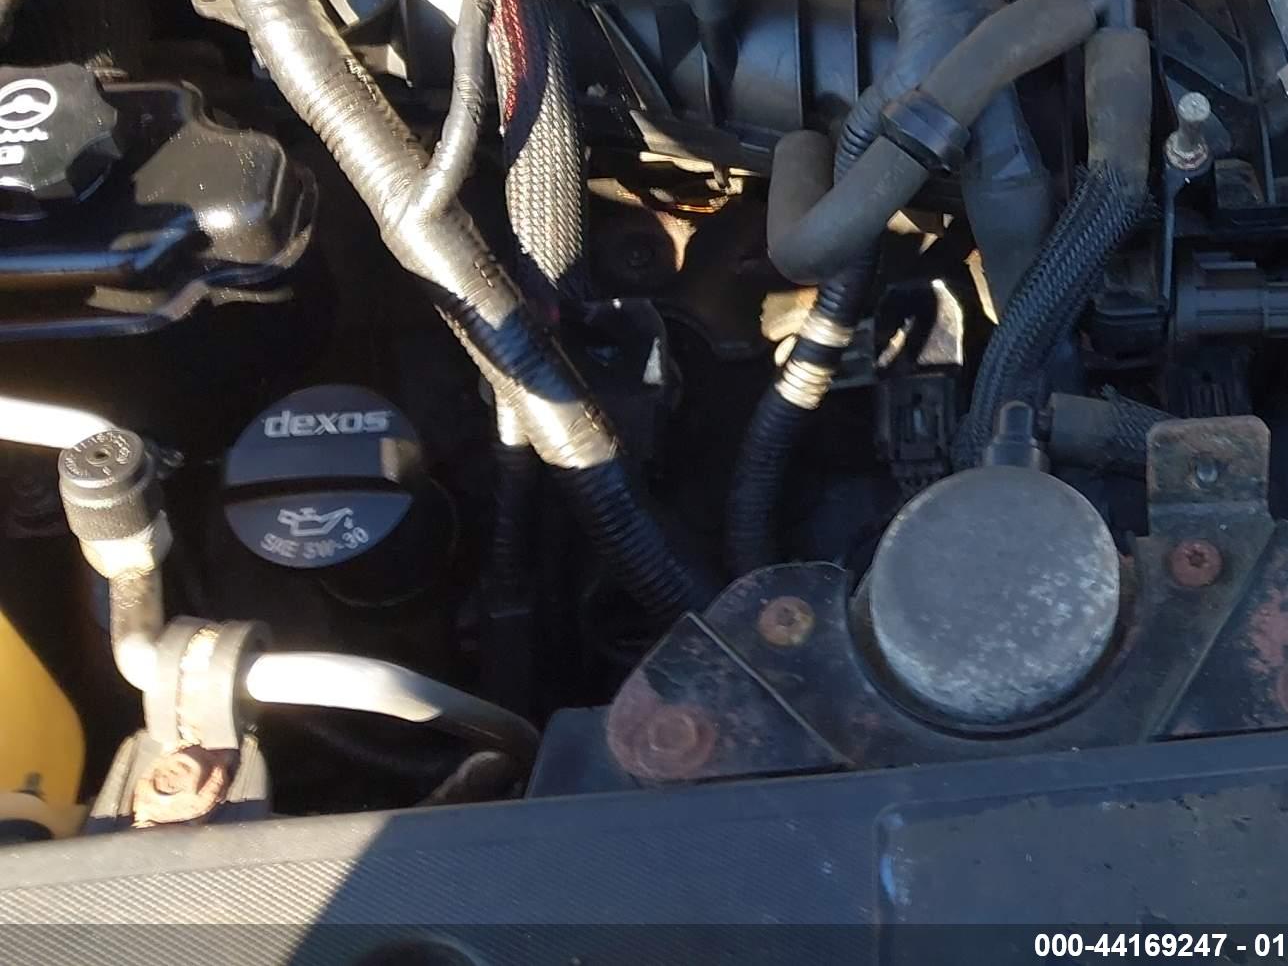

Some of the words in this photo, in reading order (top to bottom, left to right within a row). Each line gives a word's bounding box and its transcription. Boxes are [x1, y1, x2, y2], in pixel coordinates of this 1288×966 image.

[263, 409, 389, 438] dexos
[260, 532, 299, 559] SAE
[302, 527, 369, 560] 5W-30
